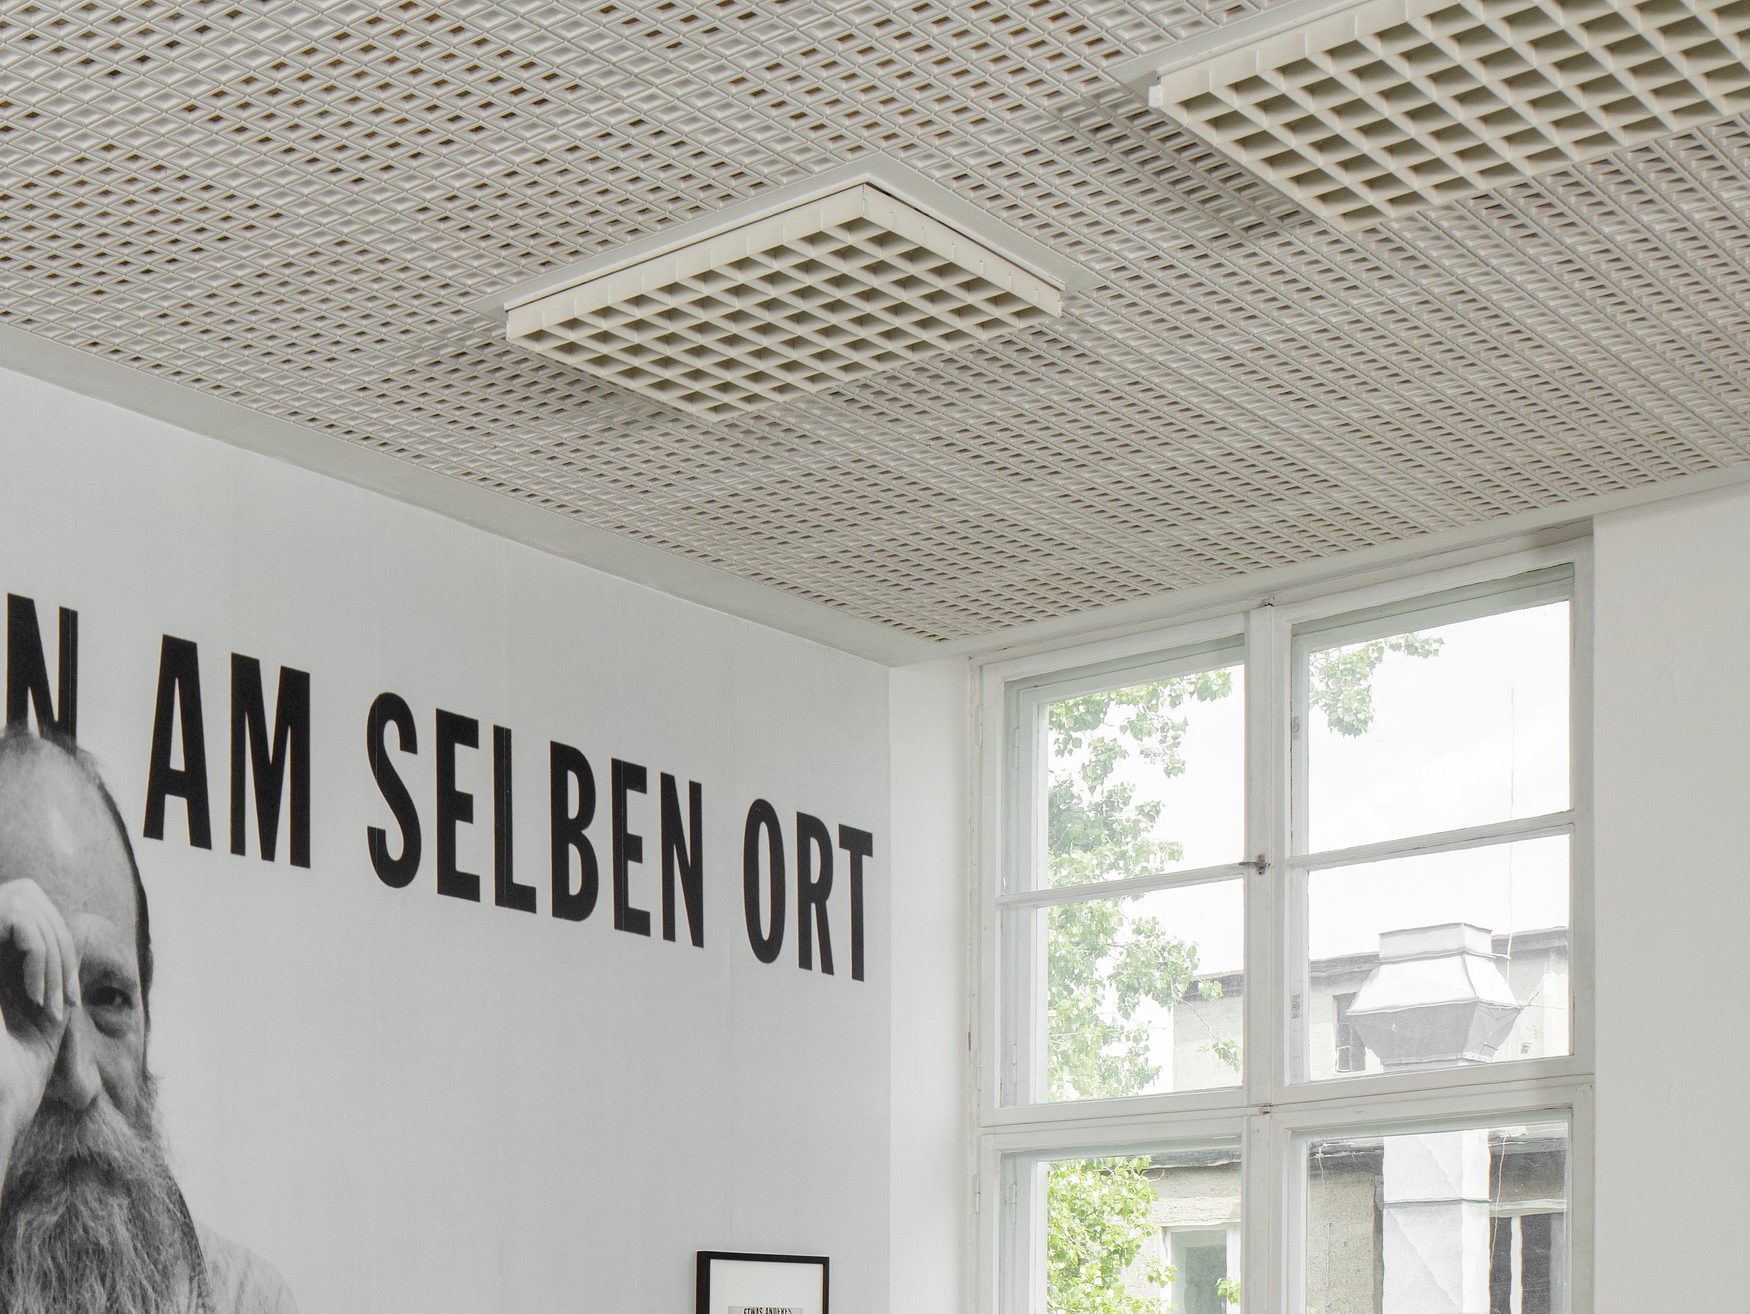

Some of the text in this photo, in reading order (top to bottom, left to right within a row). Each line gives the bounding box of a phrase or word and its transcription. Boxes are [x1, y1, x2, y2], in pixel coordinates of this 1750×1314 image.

[142, 634, 311, 869] AM
[366, 692, 704, 949] SELBEN
[743, 798, 874, 982] ORT
